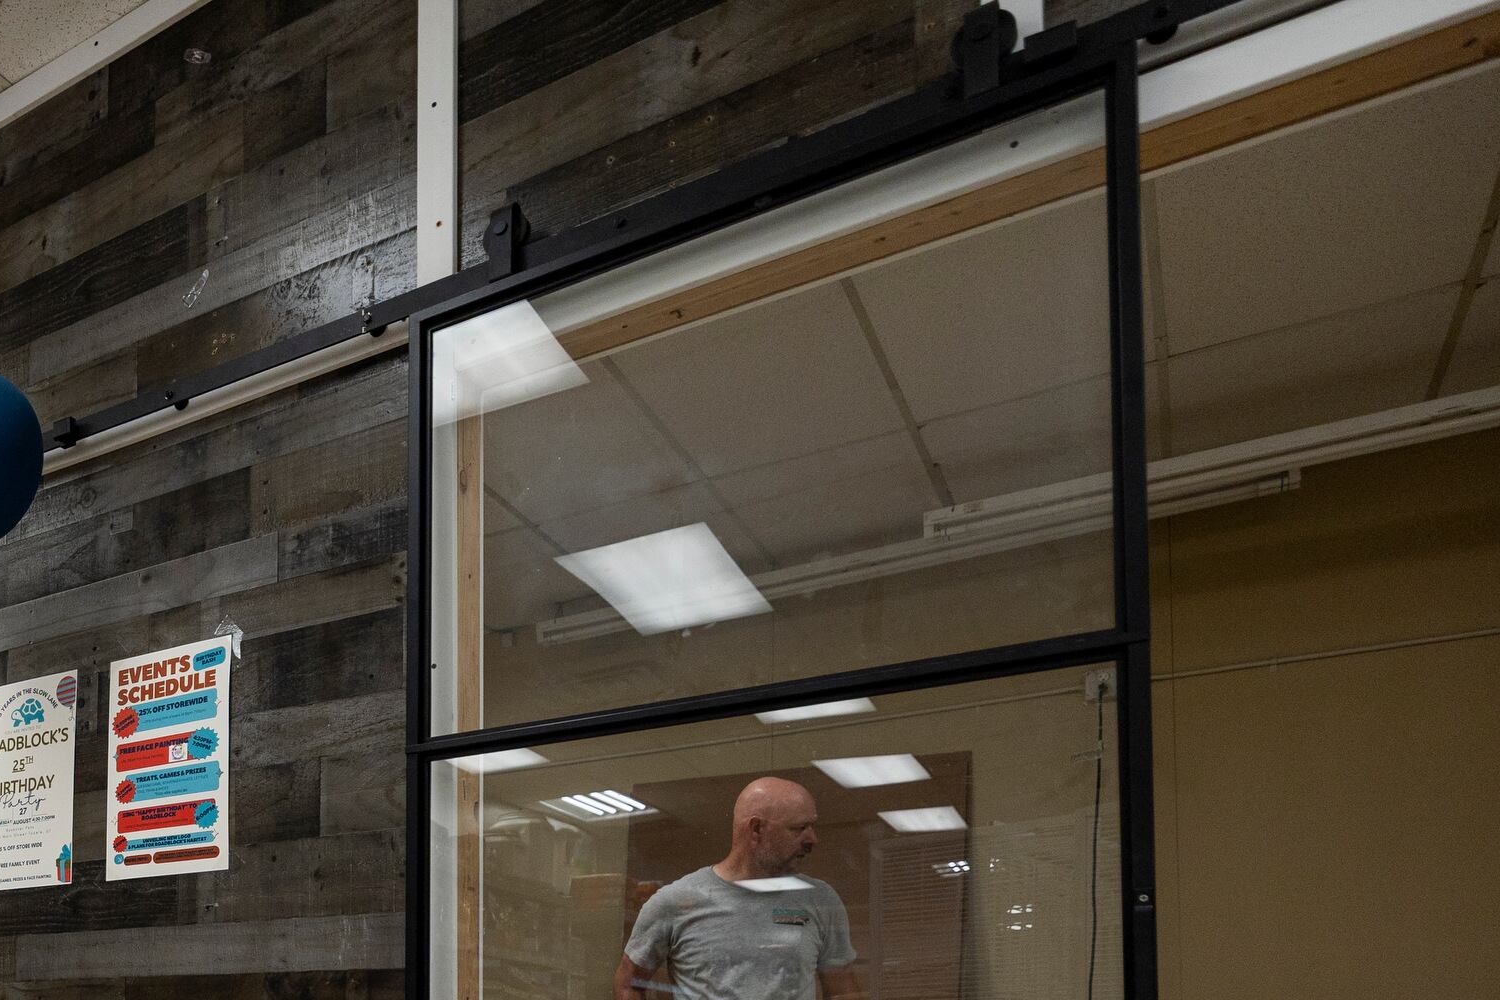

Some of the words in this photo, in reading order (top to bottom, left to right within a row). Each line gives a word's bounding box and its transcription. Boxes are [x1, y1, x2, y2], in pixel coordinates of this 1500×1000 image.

[196, 650, 222, 662] BIRTHDAY
[118, 654, 190, 686] EVENTS
[118, 669, 216, 706] SCHEDULE
[1, 694, 17, 712] YEARS
[33, 688, 48, 698] SLOW
[47, 695, 58, 708] LANE
[138, 707, 152, 716] 25%
[152, 705, 167, 714] OFF
[167, 696, 208, 711] STOREWIDE
[120, 746, 136, 755] FREE
[136, 743, 154, 752] FACE
[154, 737, 189, 749] PAINTING
[159, 771, 180, 780] GAMES
[186, 767, 207, 776] PRIZES
[0, 791, 46, 811] Party
[142, 812, 176, 820] ROADBLOCK
